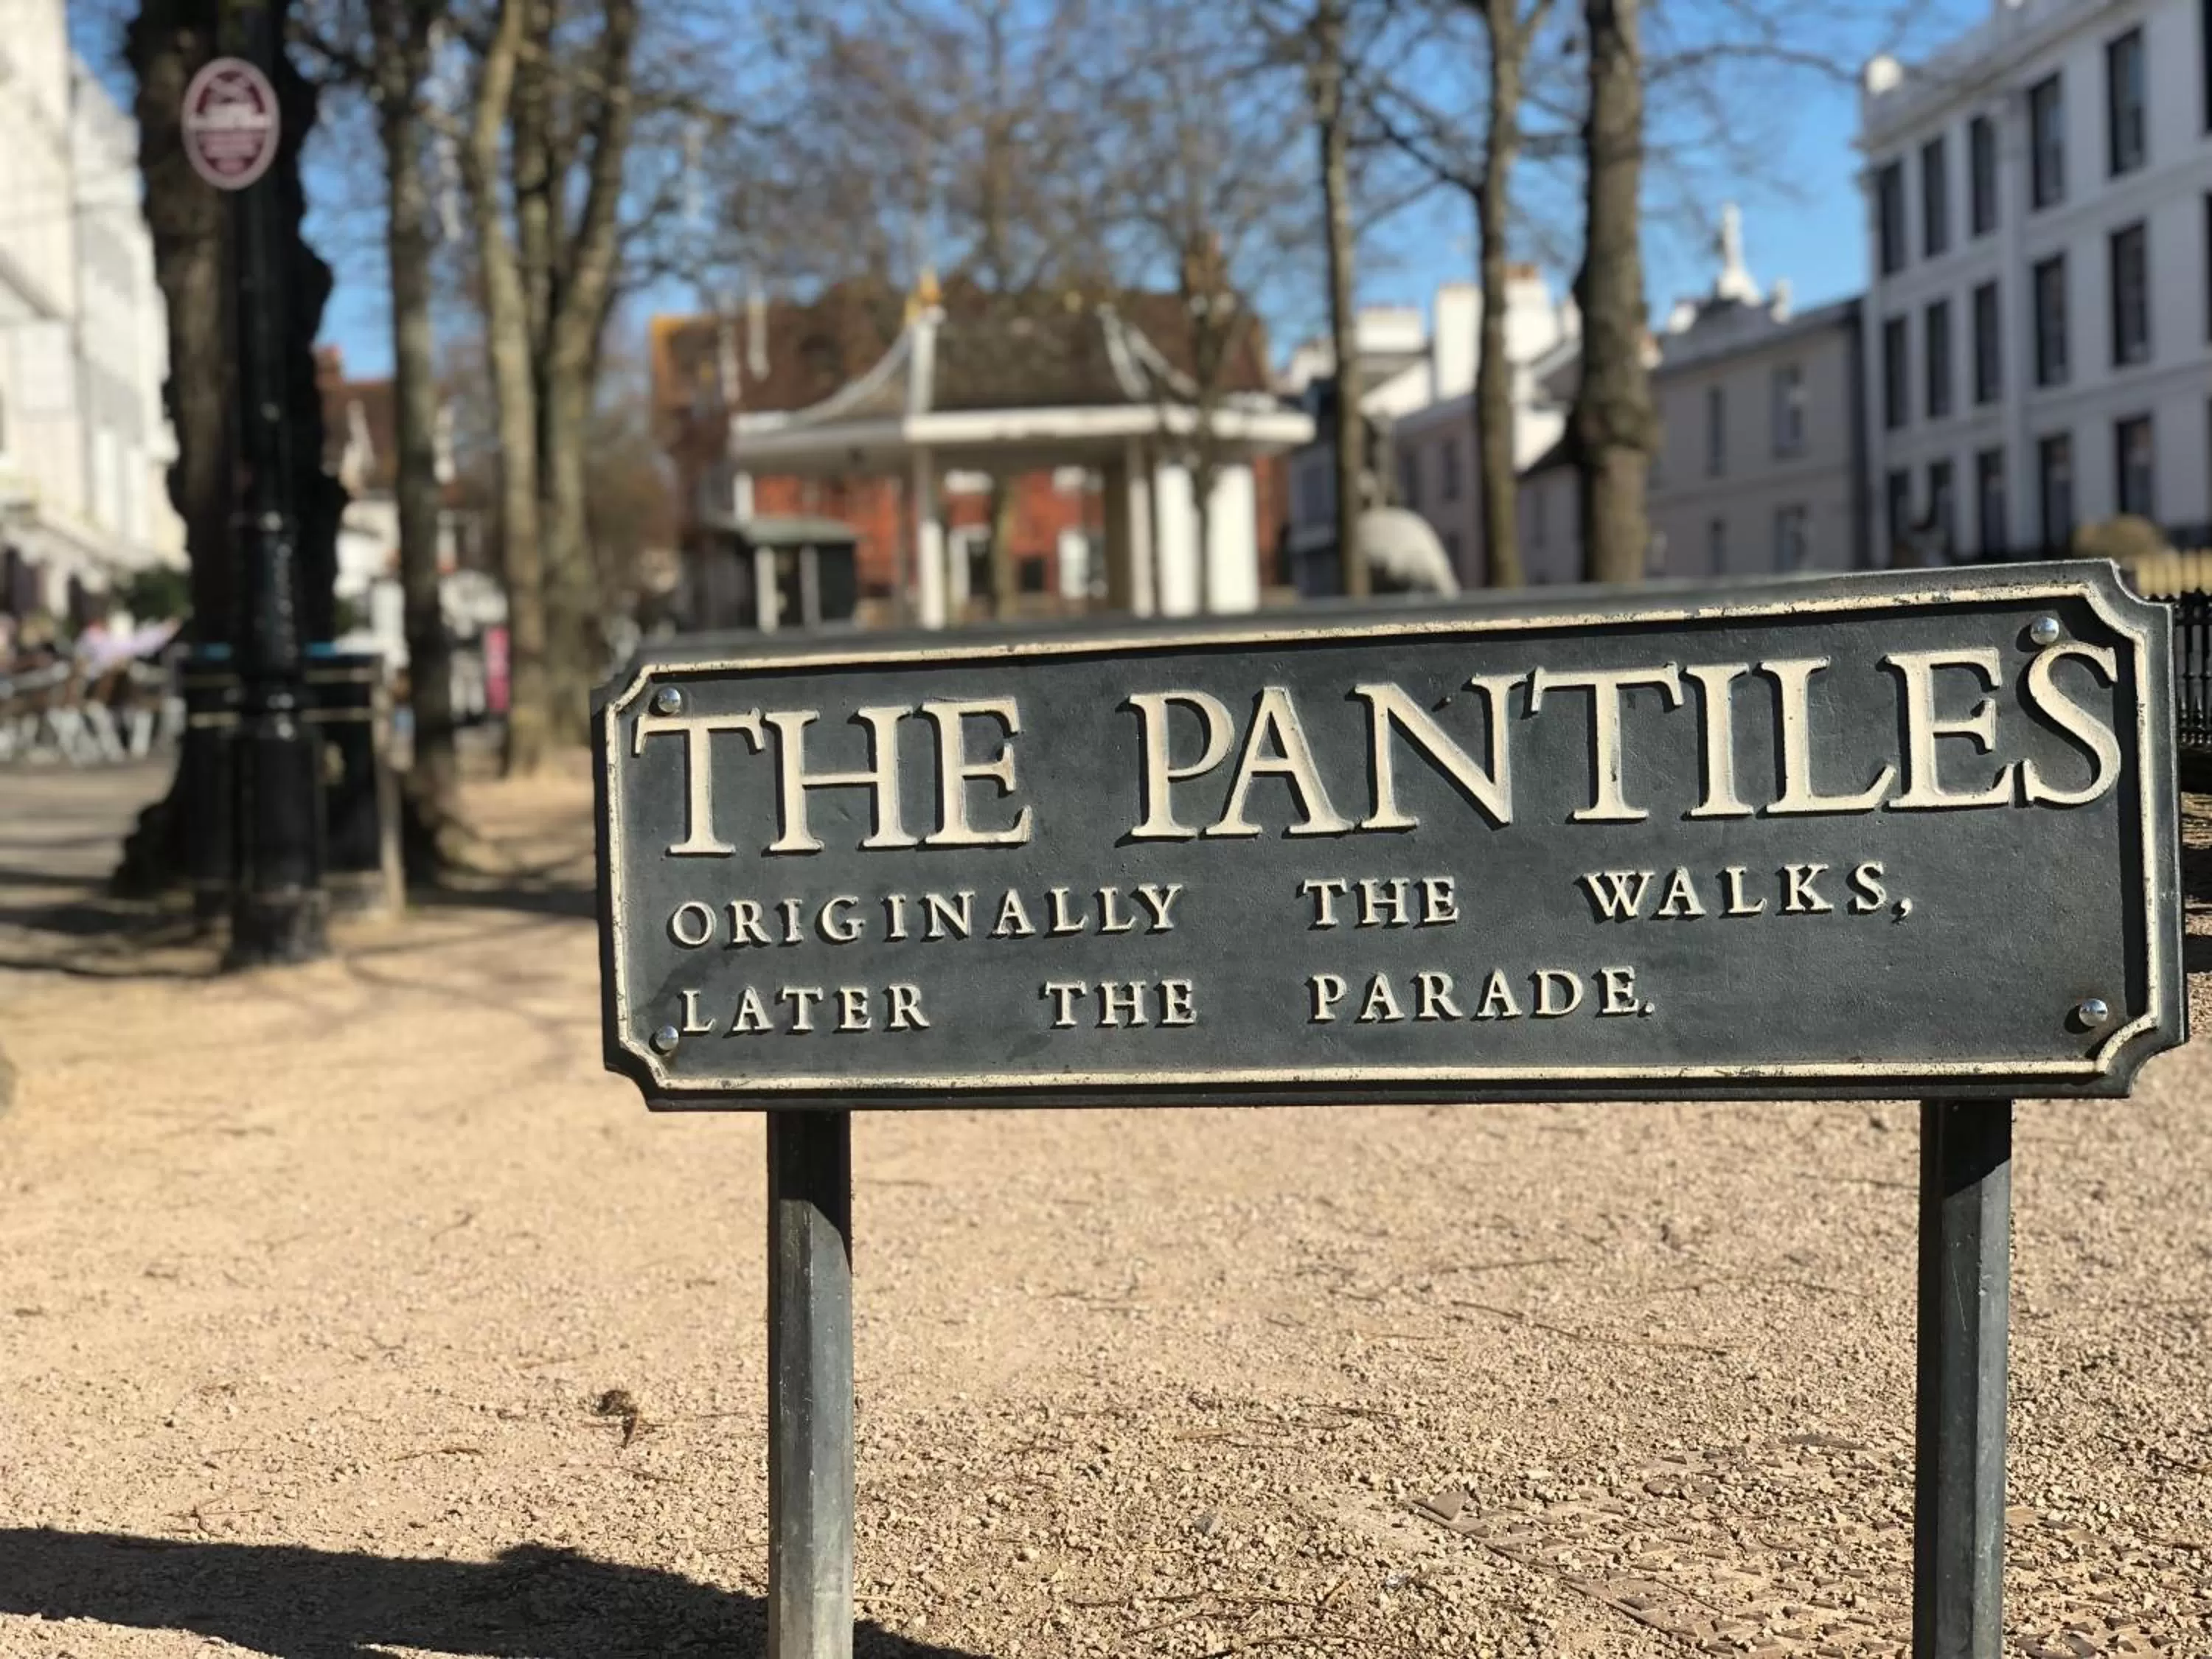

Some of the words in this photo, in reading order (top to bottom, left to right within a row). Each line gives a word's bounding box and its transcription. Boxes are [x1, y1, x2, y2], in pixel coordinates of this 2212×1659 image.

[633, 697, 1032, 854] THE
[1128, 640, 2122, 838] PANTILES
[671, 884, 1183, 945] ORIGINALLY
[1302, 875, 1461, 927] THE
[1582, 861, 1913, 919] WALKS,
[681, 983, 931, 1032] LATER
[1044, 978, 1197, 1027] THE
[1312, 966, 1655, 1022] PARADE.
